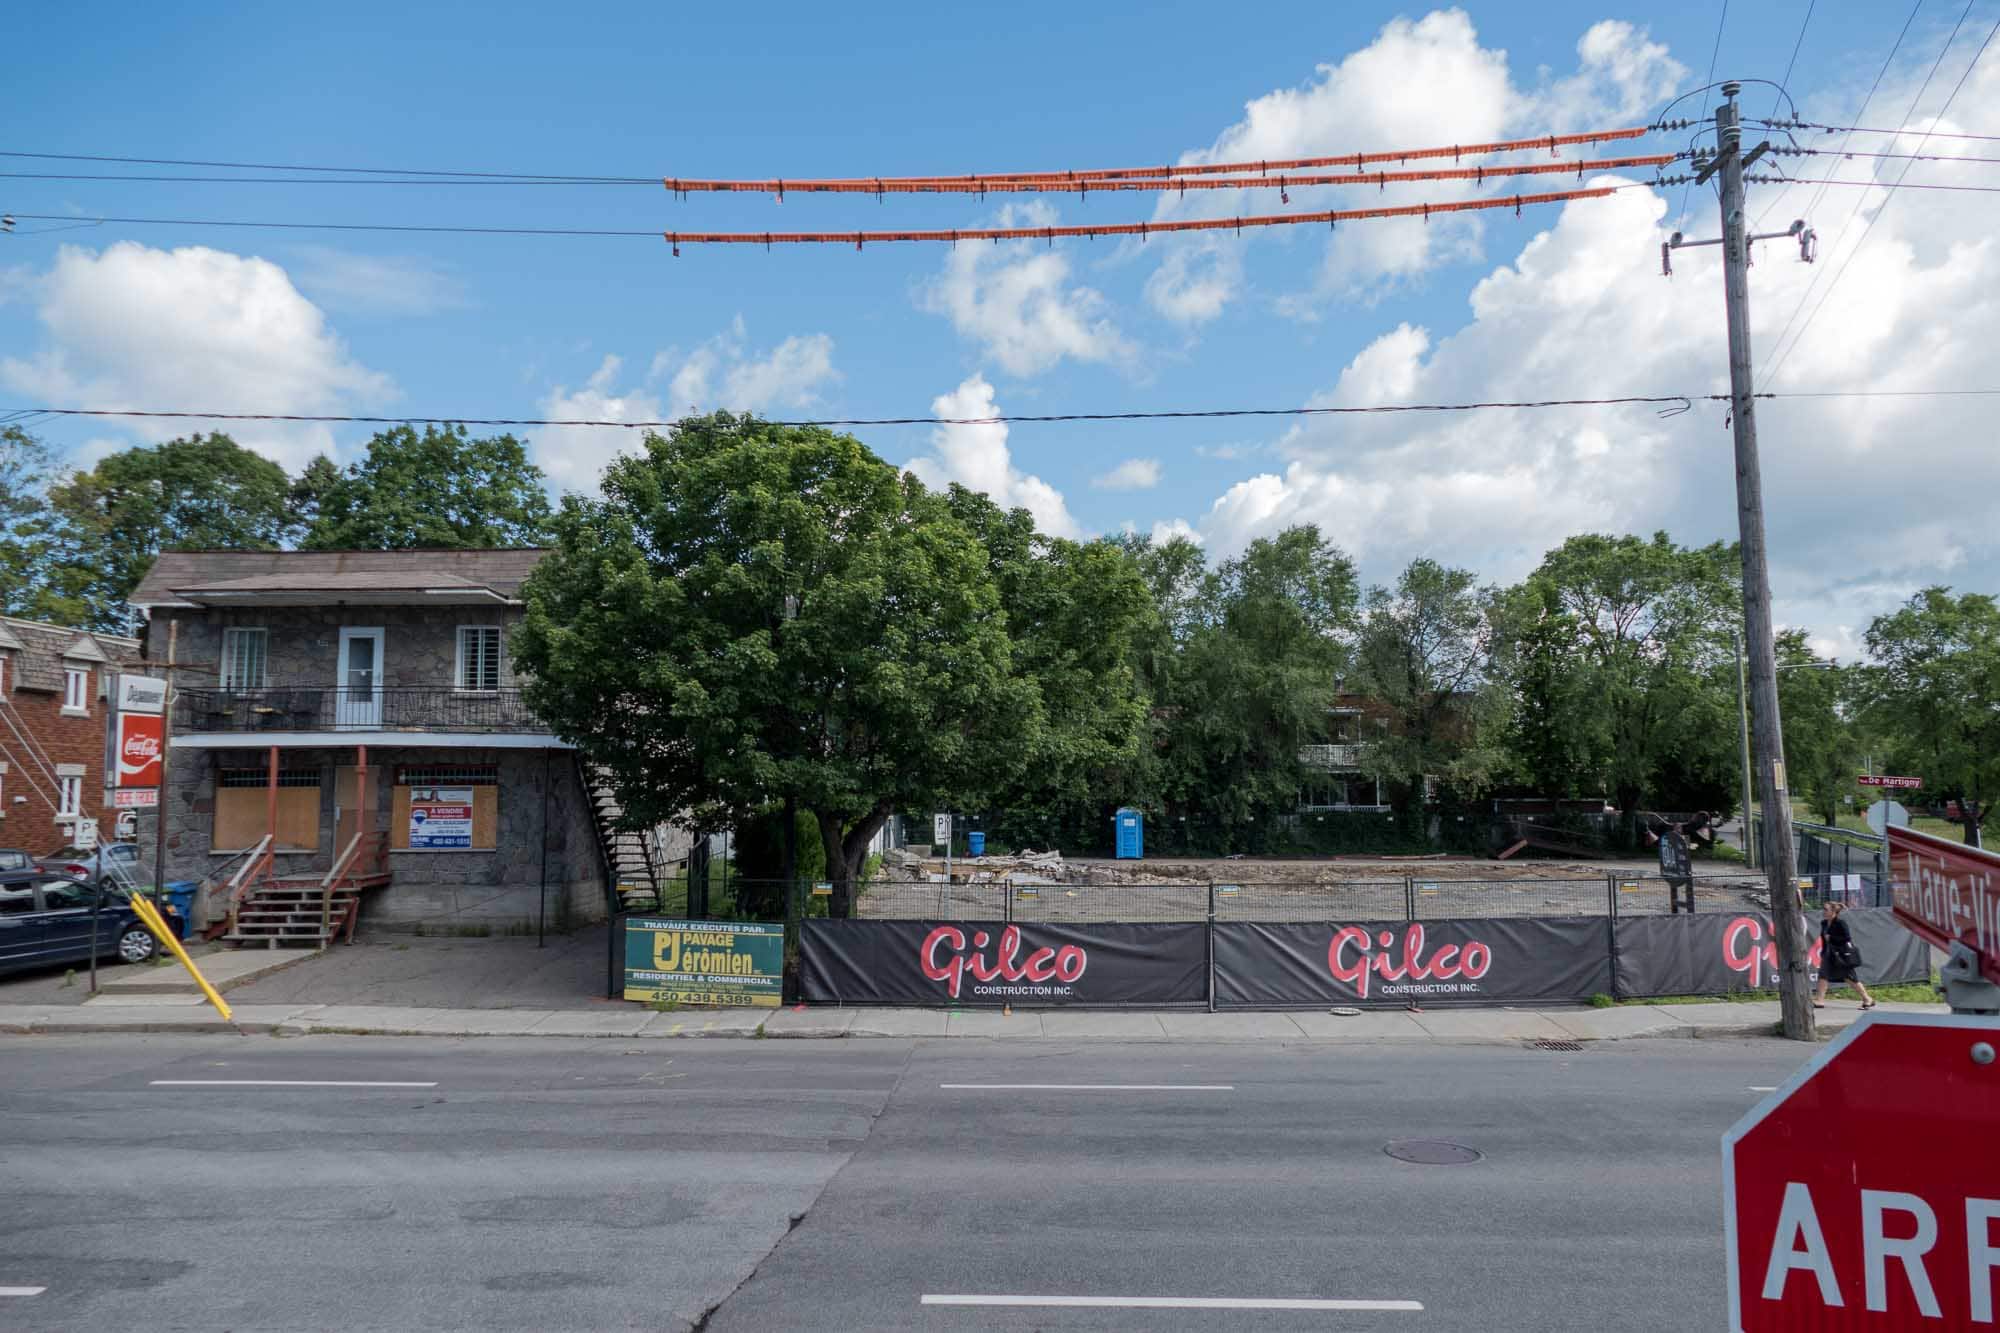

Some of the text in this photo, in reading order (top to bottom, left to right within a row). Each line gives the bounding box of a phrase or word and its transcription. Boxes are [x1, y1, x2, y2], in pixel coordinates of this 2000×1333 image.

[1882, 778, 1920, 788] Martigny
[644, 921, 688, 930] TRAVAUX
[683, 933, 735, 947] PAVAGE
[920, 924, 1087, 999] Gilco
[1328, 922, 1492, 999] Gilco
[707, 975, 773, 985] COMMERCIAL
[973, 985, 1073, 996] CONSTRUCTION INC.
[1381, 983, 1480, 994] CONSTRUCTION INC.
